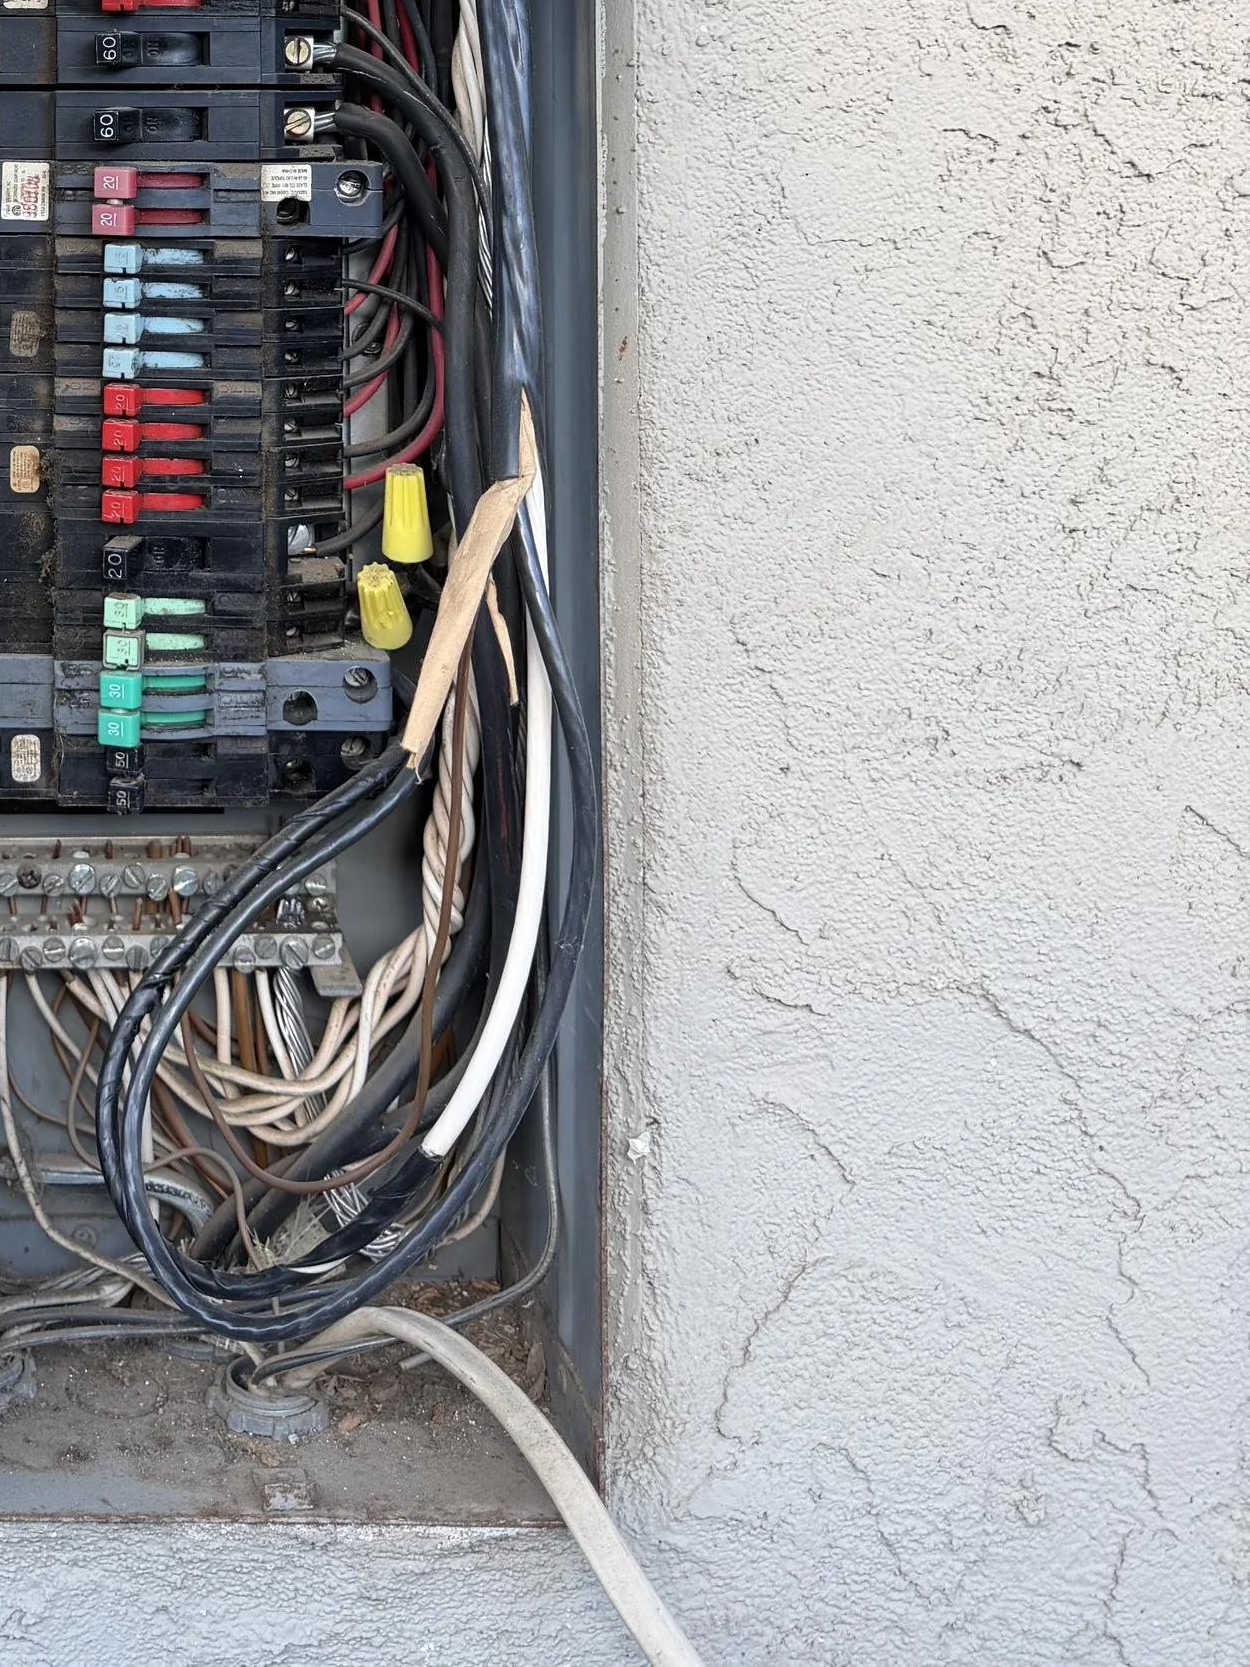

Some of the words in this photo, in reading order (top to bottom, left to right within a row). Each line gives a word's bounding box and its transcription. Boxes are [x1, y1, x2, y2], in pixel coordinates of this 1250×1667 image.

[102, 36, 117, 61] 60
[99, 114, 114, 138] 60
[103, 175, 114, 190] 20
[100, 212, 112, 227] 20
[115, 393, 126, 410] 20
[113, 429, 124, 446] 20
[111, 465, 122, 482] 20
[108, 552, 123, 579] 20
[109, 683, 122, 698] 30
[107, 722, 120, 736] 30
[115, 751, 126, 768] 50
[116, 790, 127, 807] 50
